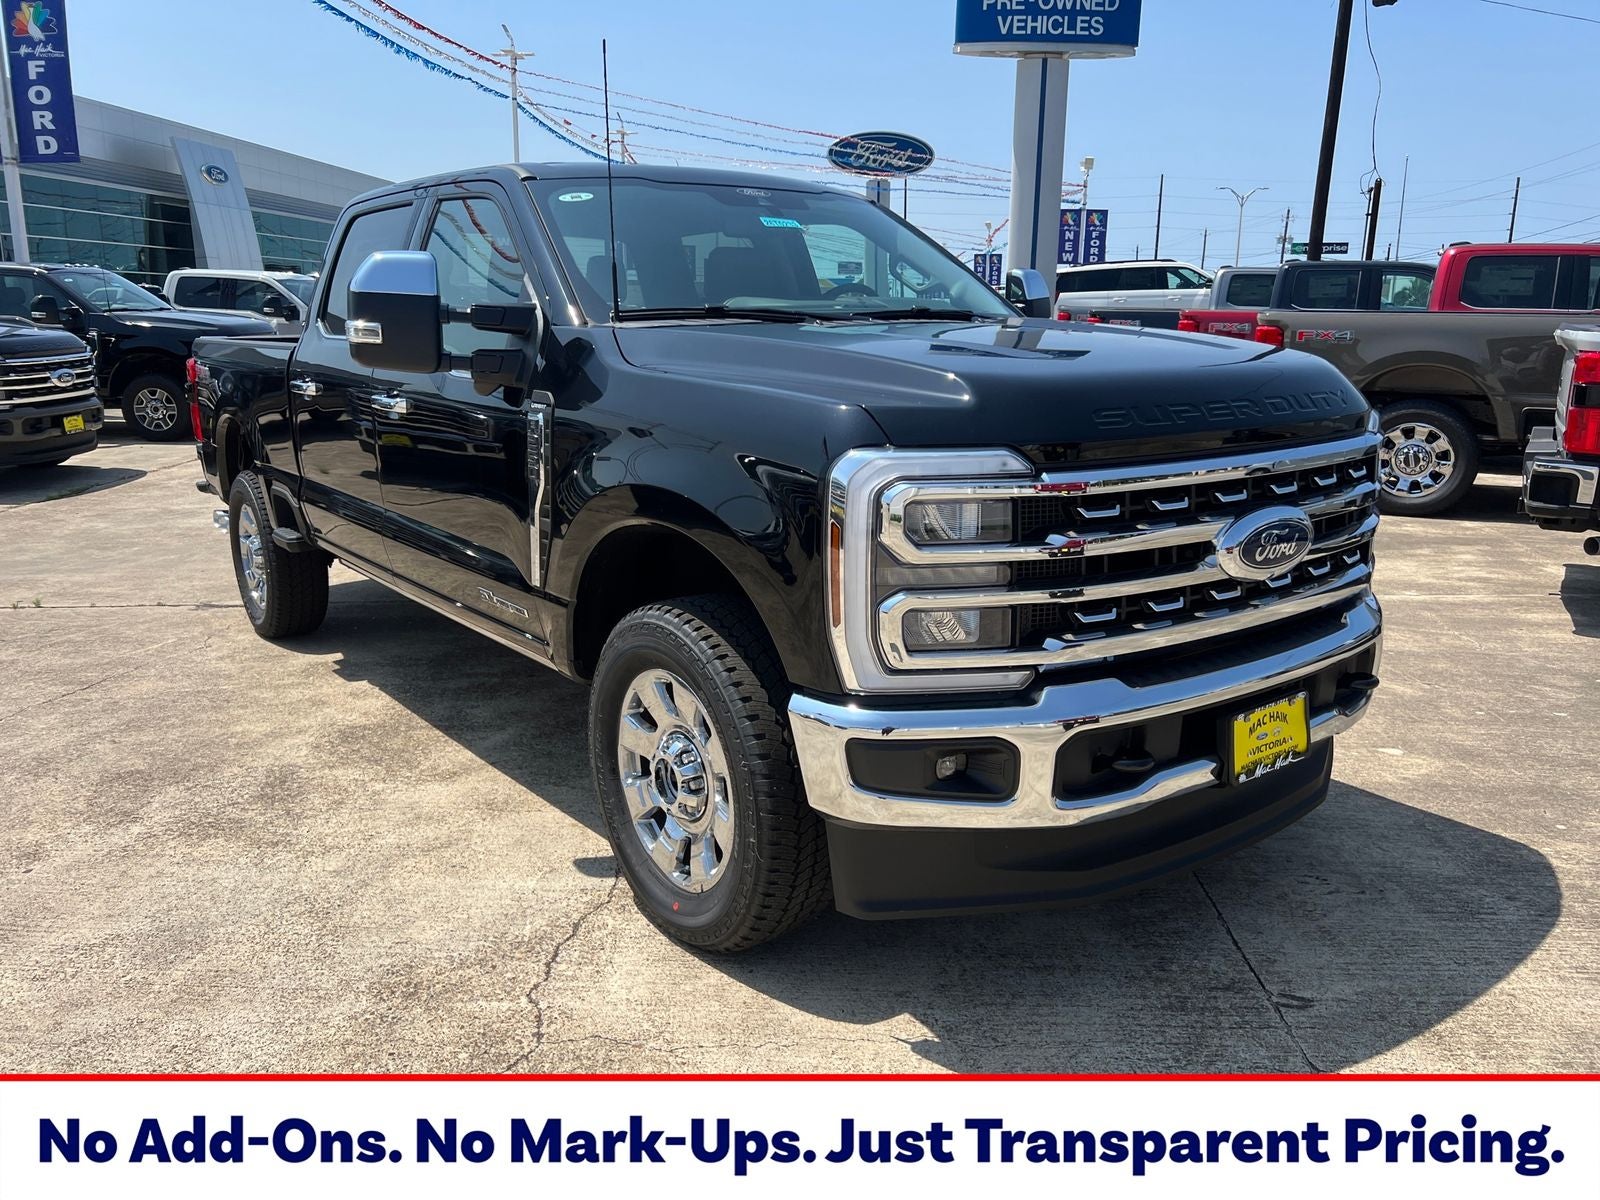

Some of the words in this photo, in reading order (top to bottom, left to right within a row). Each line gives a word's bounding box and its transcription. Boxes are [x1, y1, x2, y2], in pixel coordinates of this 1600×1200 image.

[982, 0, 1120, 12] PRE-OWNED
[997, 15, 1104, 36] VEHICLES
[27, 60, 58, 155] FORD
[850, 140, 914, 167] Ford
[1062, 230, 1075, 262] NEW
[1089, 231, 1100, 263] FORD
[1296, 244, 1347, 253] enprise
[1207, 322, 1252, 334] FX4
[1296, 329, 1355, 344] FX4
[1091, 399, 1263, 429] SUPER
[1264, 389, 1349, 416] DUTY
[1255, 527, 1300, 562] Ford
[1248, 713, 1268, 738] MAC
[1268, 710, 1289, 725] HAIK
[1252, 736, 1288, 756] VICTORIA
[1254, 763, 1275, 778] Mac
